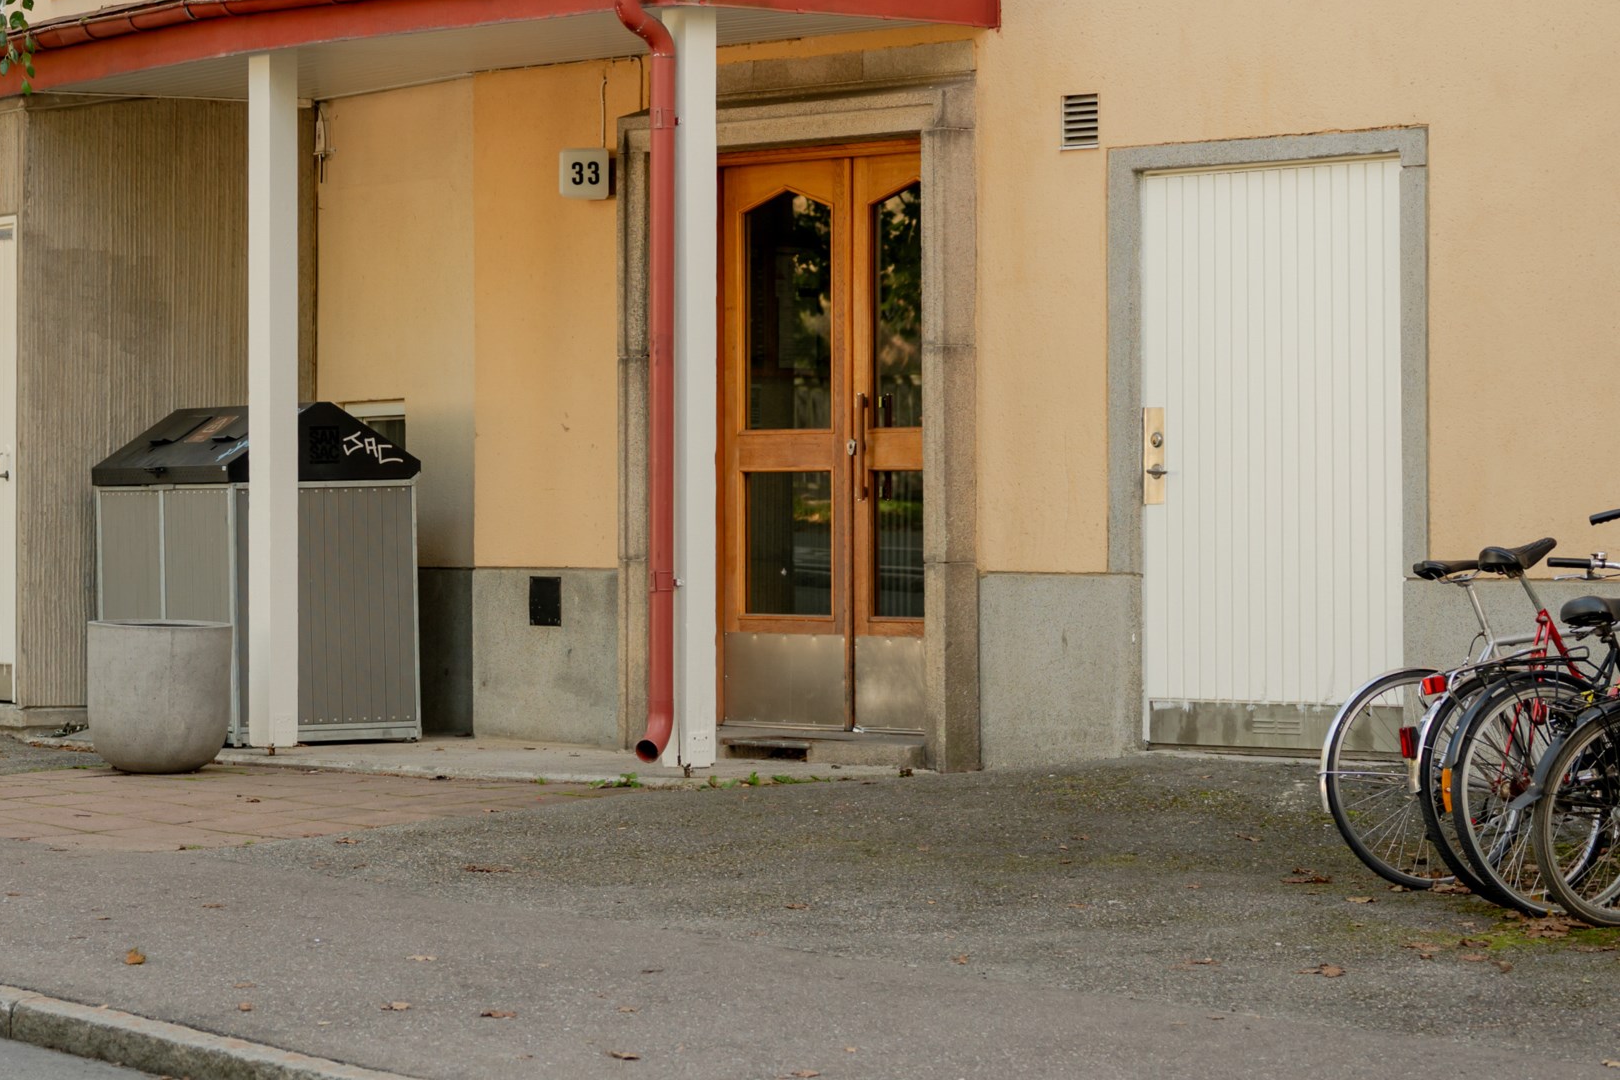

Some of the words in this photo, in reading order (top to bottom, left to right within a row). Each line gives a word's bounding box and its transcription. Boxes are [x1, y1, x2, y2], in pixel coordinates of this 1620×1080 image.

[571, 161, 600, 185] 33
[309, 430, 340, 445] SAN
[309, 444, 340, 460] SAC
